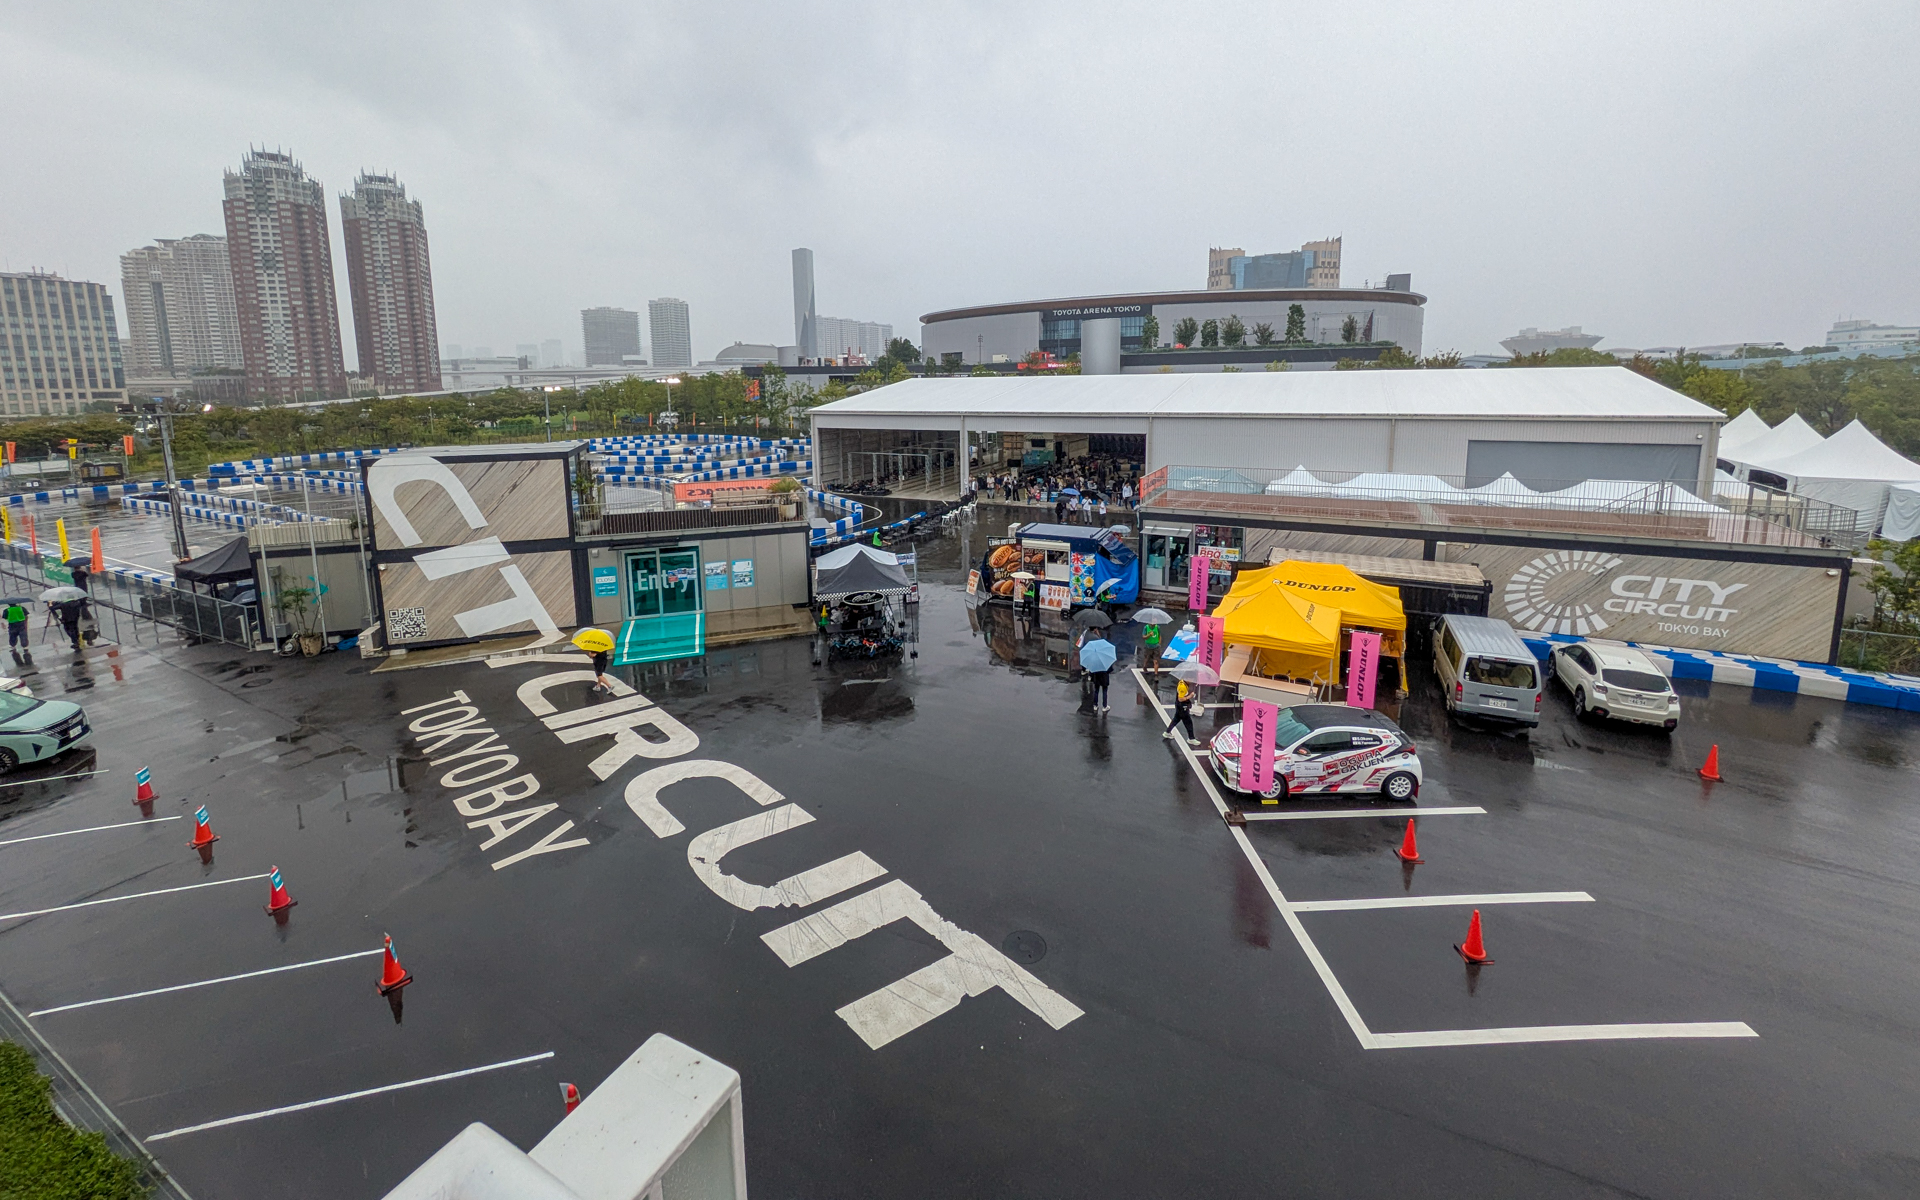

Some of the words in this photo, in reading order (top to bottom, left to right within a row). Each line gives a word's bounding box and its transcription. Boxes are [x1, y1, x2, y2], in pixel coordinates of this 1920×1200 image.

[1071, 552, 1084, 565] 氷
[1200, 549, 1221, 559] BBQ
[1284, 580, 1356, 593] DUNLOP
[1610, 575, 1749, 606] CITY
[1603, 598, 1739, 622] CIRCUIT
[1657, 622, 1699, 635] TOKYO
[1702, 627, 1730, 638] BAY
[584, 640, 609, 648] DUNLOP
[1205, 631, 1214, 668] DUNL
[1356, 648, 1368, 702] DUNLOP
[1252, 720, 1264, 784] DUNLOP
[1339, 749, 1382, 768] OGURA
[517, 671, 1085, 1050] CIRCUIT
